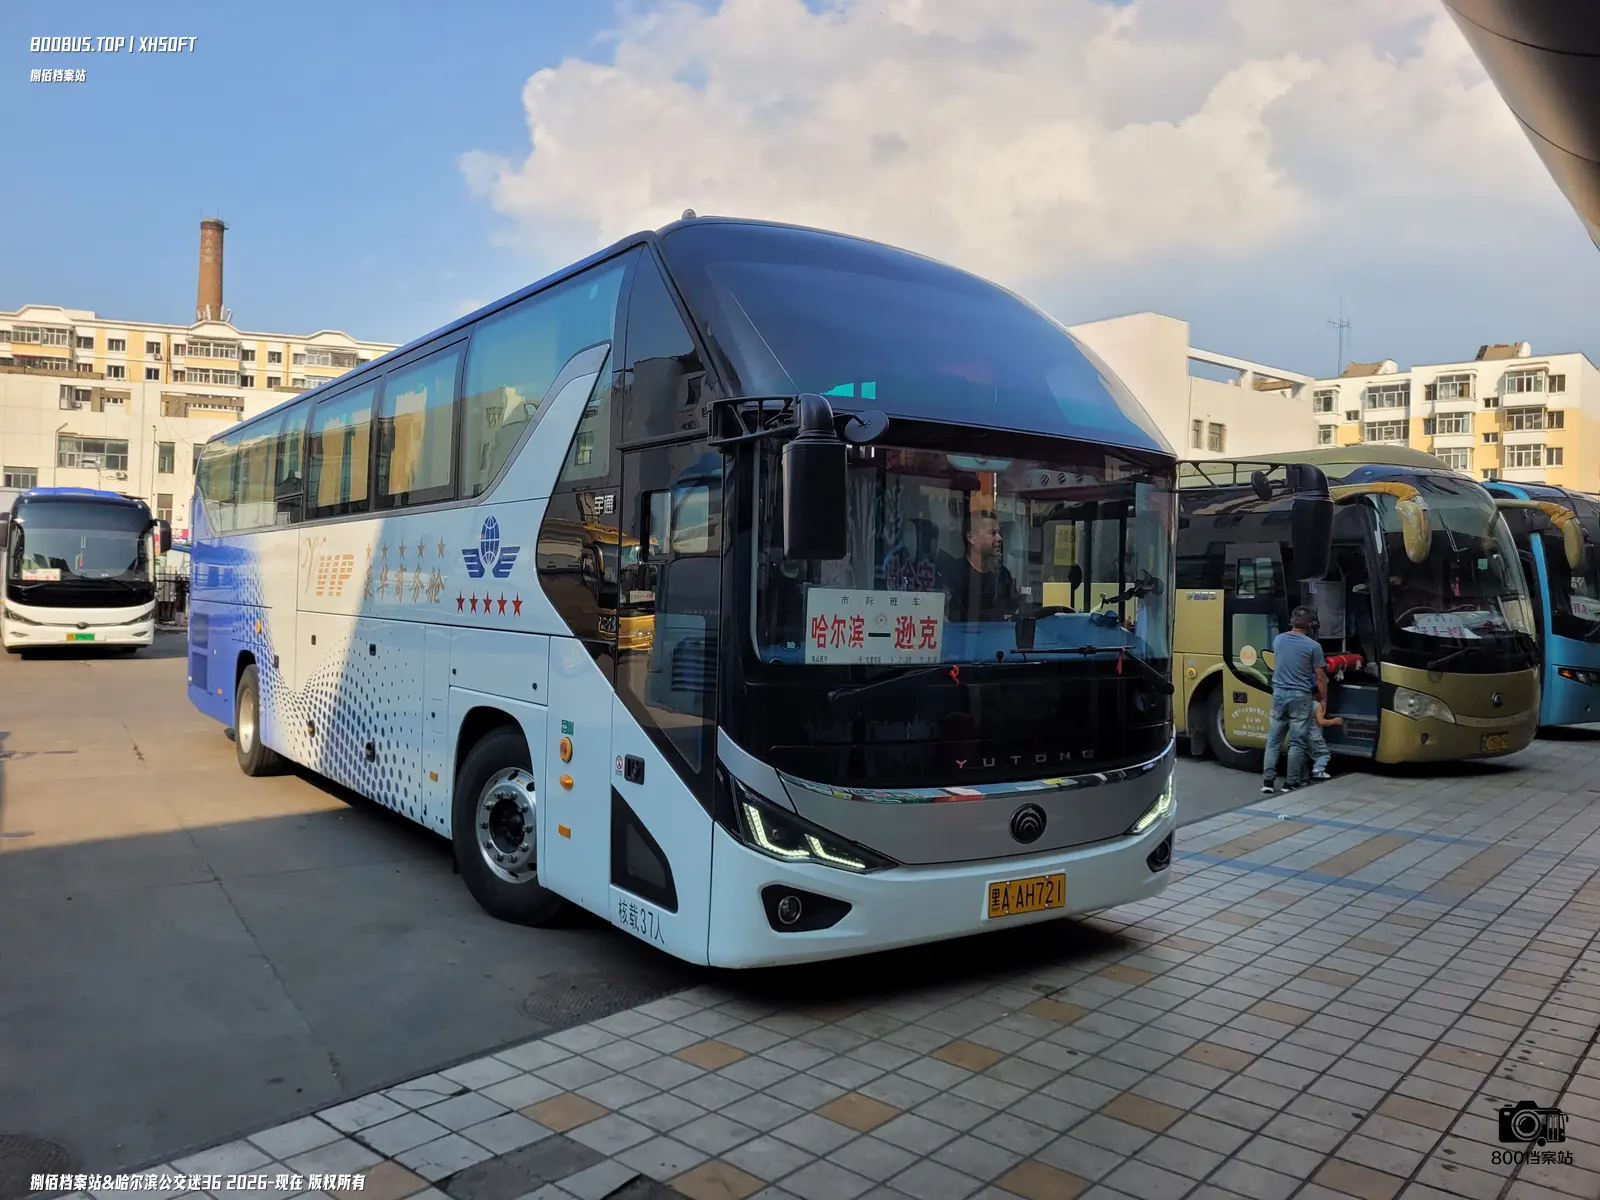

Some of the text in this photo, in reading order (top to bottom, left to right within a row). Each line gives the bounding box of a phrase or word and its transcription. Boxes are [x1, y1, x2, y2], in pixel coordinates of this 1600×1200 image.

[594, 495, 615, 515] 宇通
[841, 596, 921, 607] 市际班车
[955, 749, 1095, 769] YUTONG
